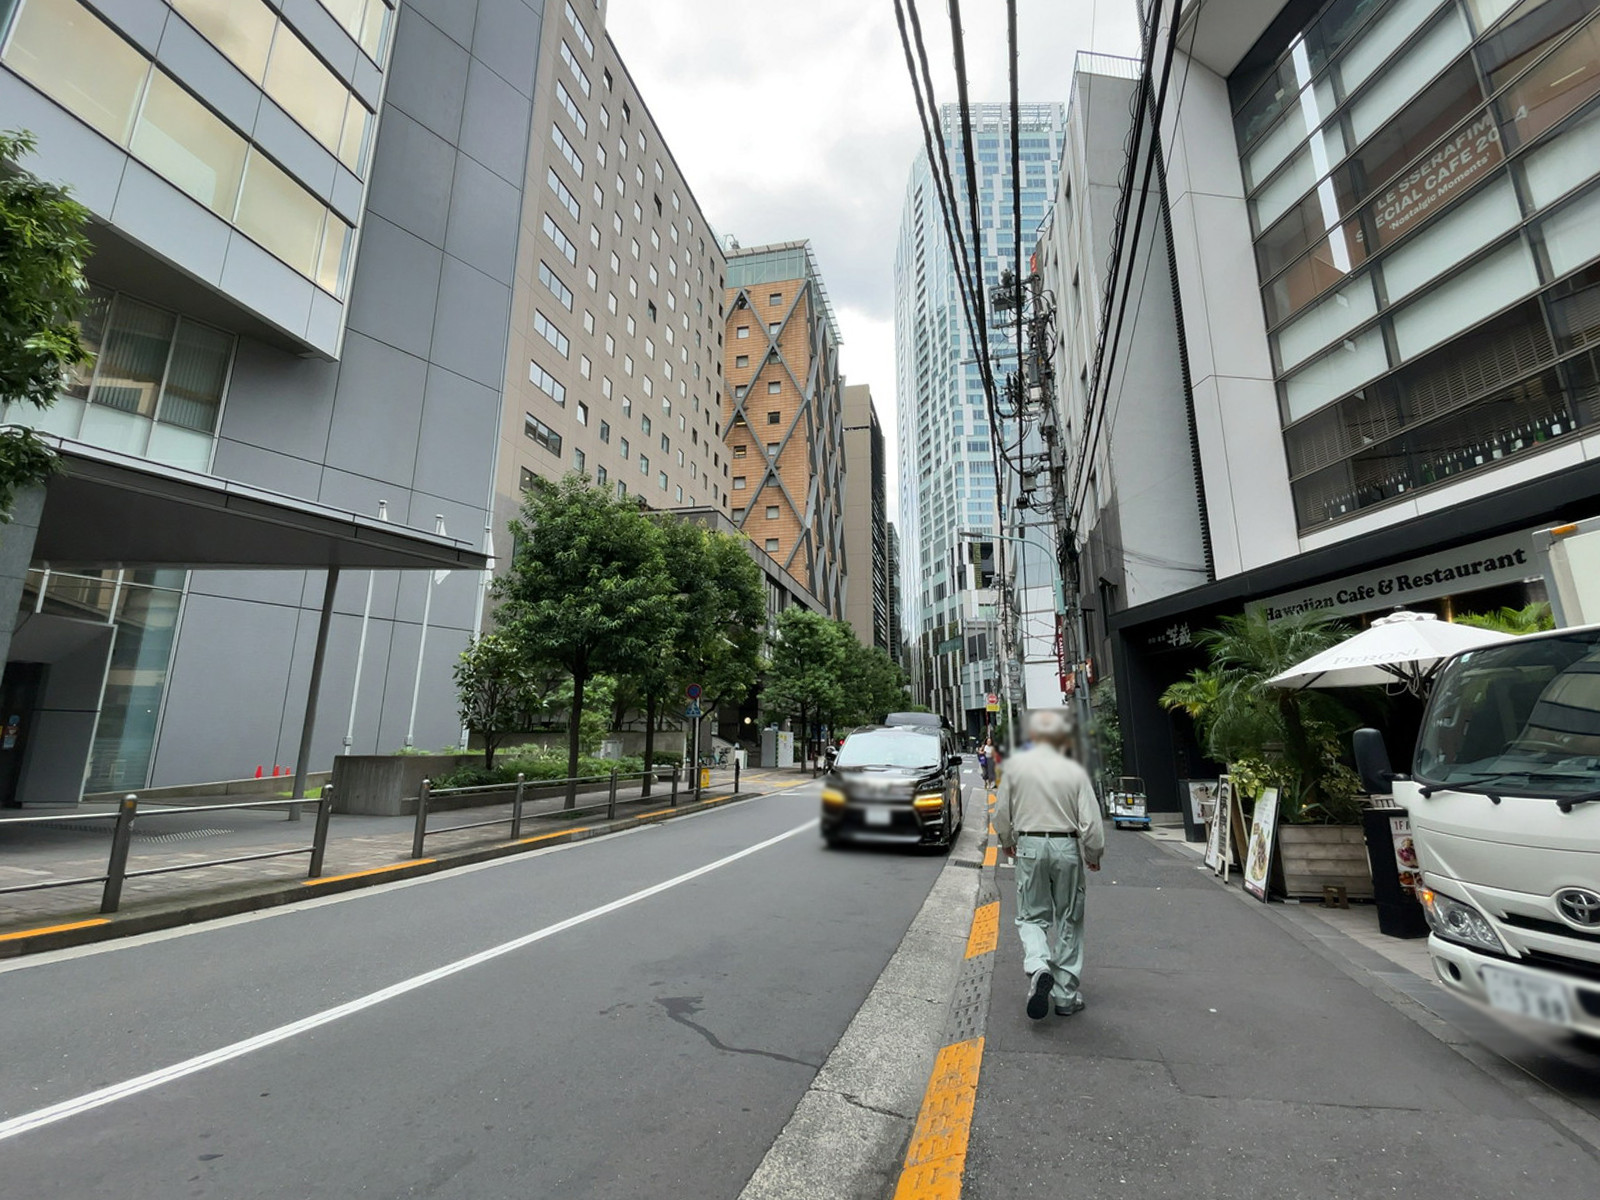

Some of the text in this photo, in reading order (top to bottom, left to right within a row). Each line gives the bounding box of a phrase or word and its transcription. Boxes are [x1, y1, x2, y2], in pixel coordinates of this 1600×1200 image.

[1424, 146, 1473, 191] CAFE
[1377, 191, 1396, 210] LE
[1336, 585, 1376, 606] Cafe
[1378, 578, 1394, 596] &
[1397, 549, 1528, 591] Restaurant
